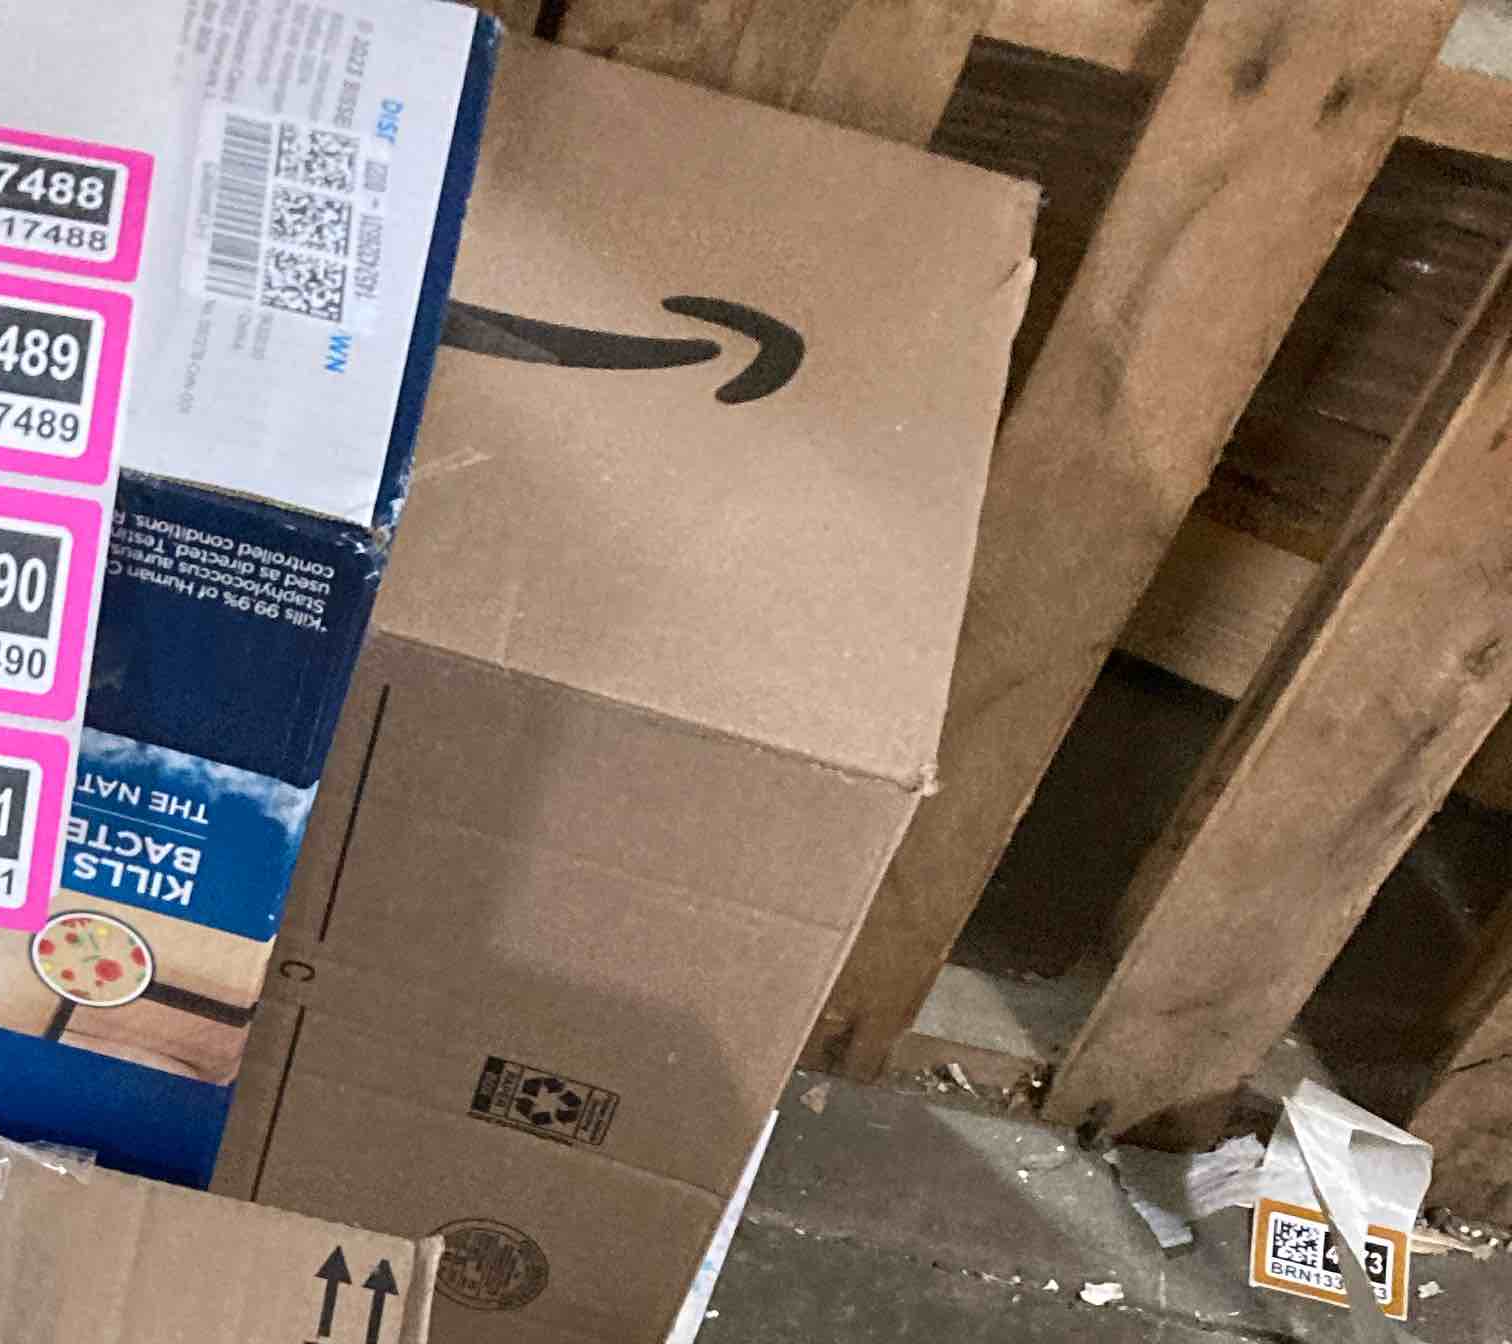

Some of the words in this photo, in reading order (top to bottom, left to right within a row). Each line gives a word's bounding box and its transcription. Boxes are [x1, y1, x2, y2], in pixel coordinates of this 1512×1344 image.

[237, 541, 336, 580] controlled
[259, 566, 282, 582] as
[126, 563, 196, 599] Human
[178, 559, 328, 615] Staphylococcus
[196, 583, 219, 601] of
[284, 573, 331, 596] used
[222, 590, 281, 620] 99.9%
[77, 773, 142, 806] NAT
[148, 790, 209, 825] THE
[66, 815, 202, 876] BACTE
[72, 851, 195, 906] KILLS
[1326, 1245, 1384, 1275] 43
[1271, 1261, 1387, 1300] BRN1333
